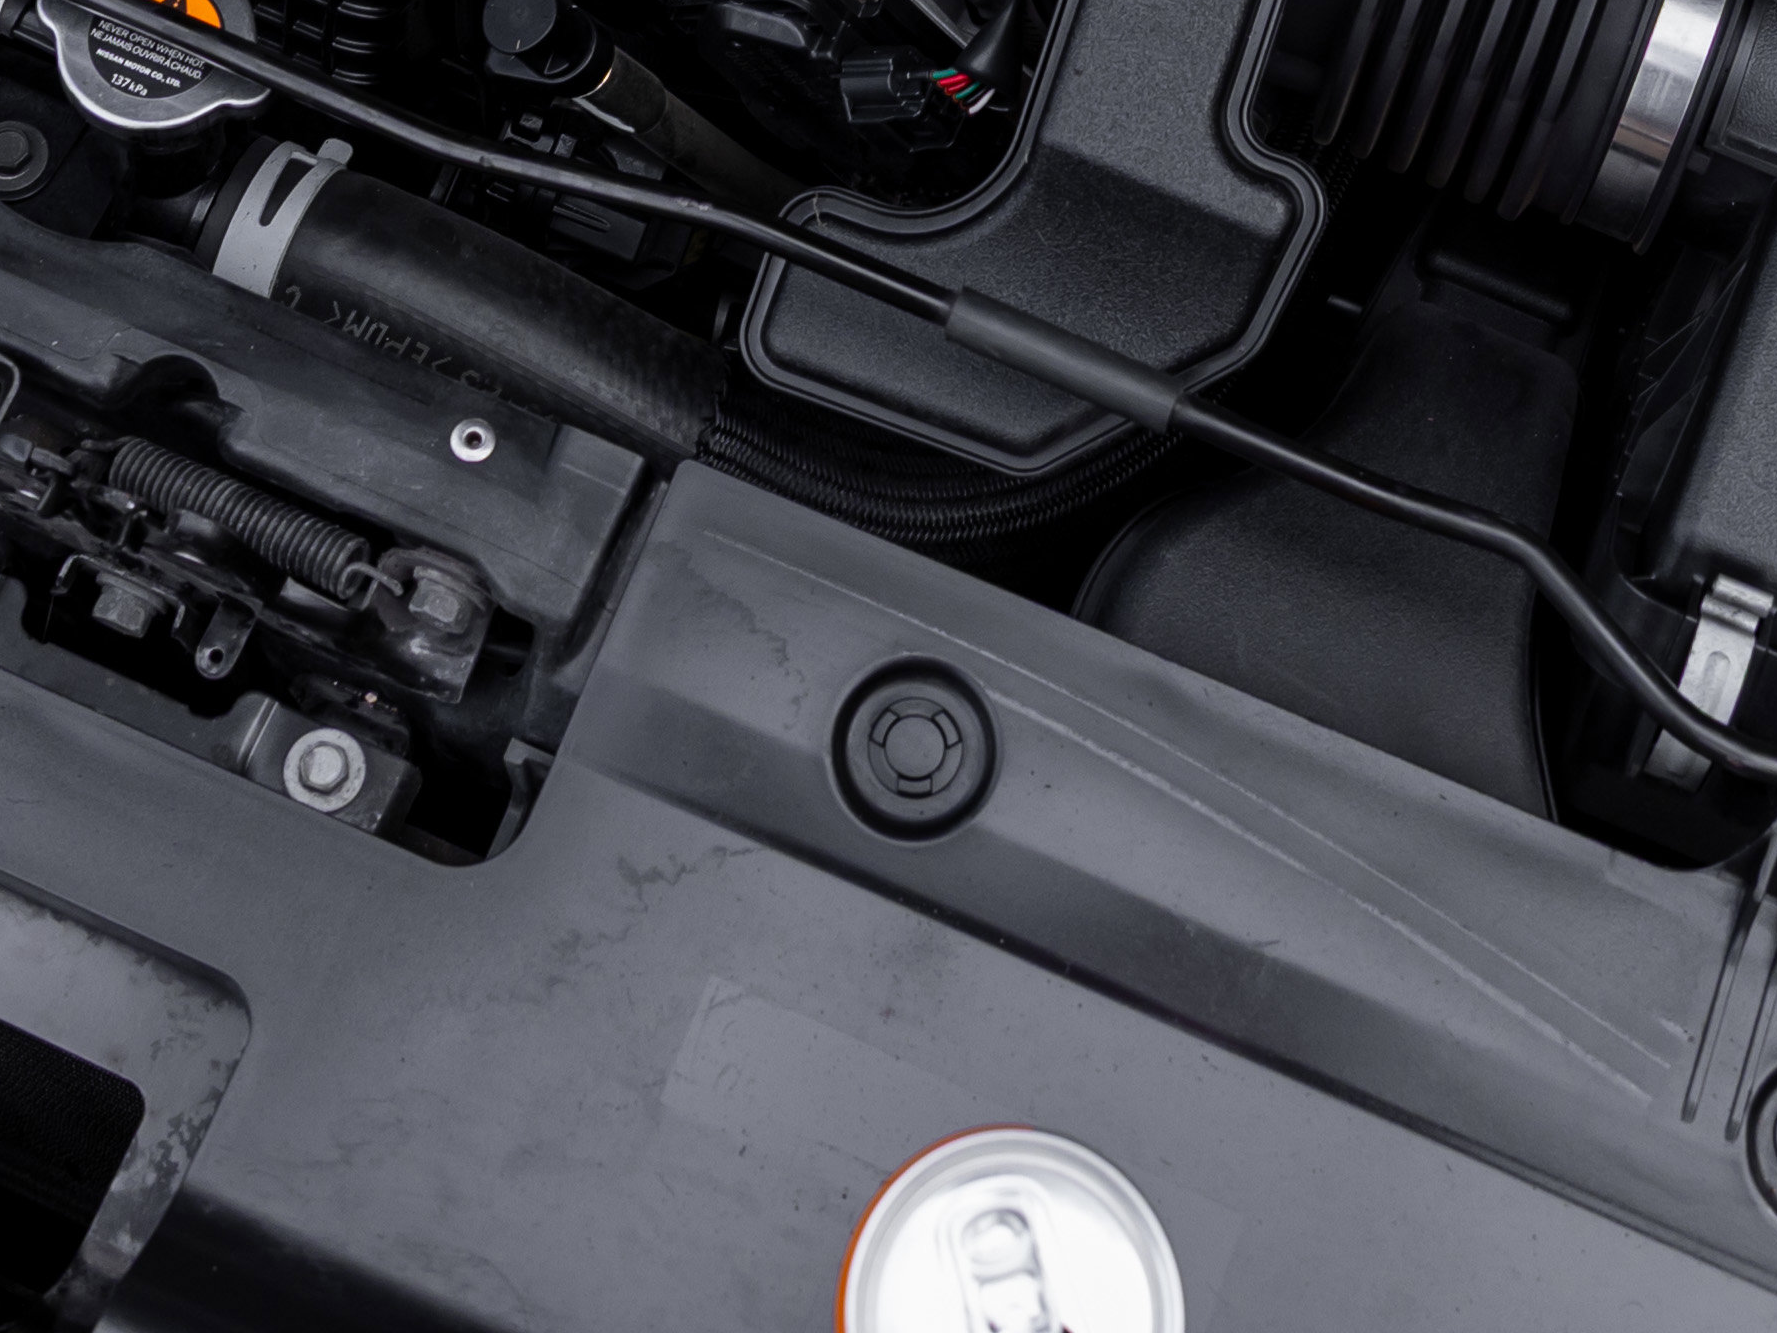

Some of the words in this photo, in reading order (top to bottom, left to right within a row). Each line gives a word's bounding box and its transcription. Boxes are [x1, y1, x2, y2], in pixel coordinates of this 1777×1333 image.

[97, 19, 129, 38] NEVER
[128, 31, 155, 49] OPEN
[154, 42, 185, 61] WHEN
[102, 32, 133, 52] JAMAIS
[131, 44, 163, 64] OUVRIR
[95, 47, 124, 64] NISSAN
[123, 58, 151, 76] MOTOR
[109, 72, 131, 89] 137
[127, 79, 149, 97] kPa
